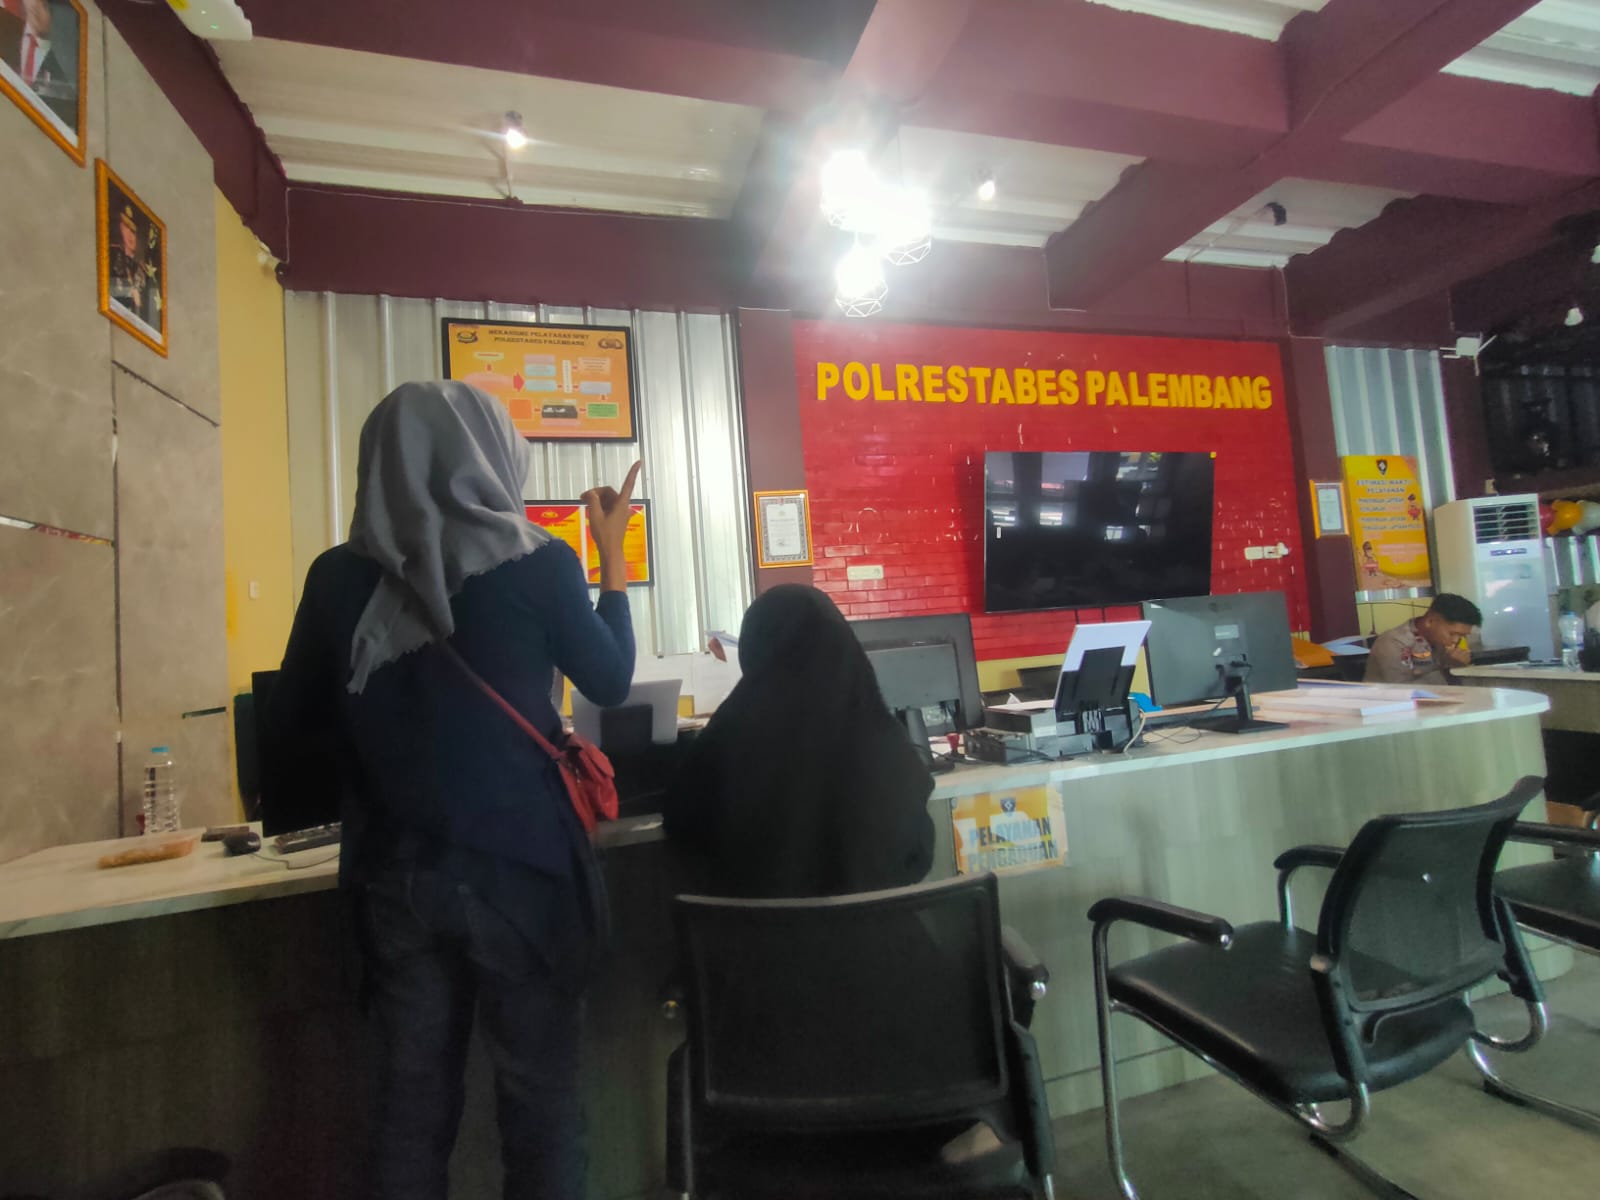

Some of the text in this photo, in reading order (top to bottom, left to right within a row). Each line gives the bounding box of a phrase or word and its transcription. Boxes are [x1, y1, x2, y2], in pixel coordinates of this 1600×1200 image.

[817, 361, 1273, 410] POLRESTABES PALEMBANG
[968, 816, 1052, 847] PELAYANAN
